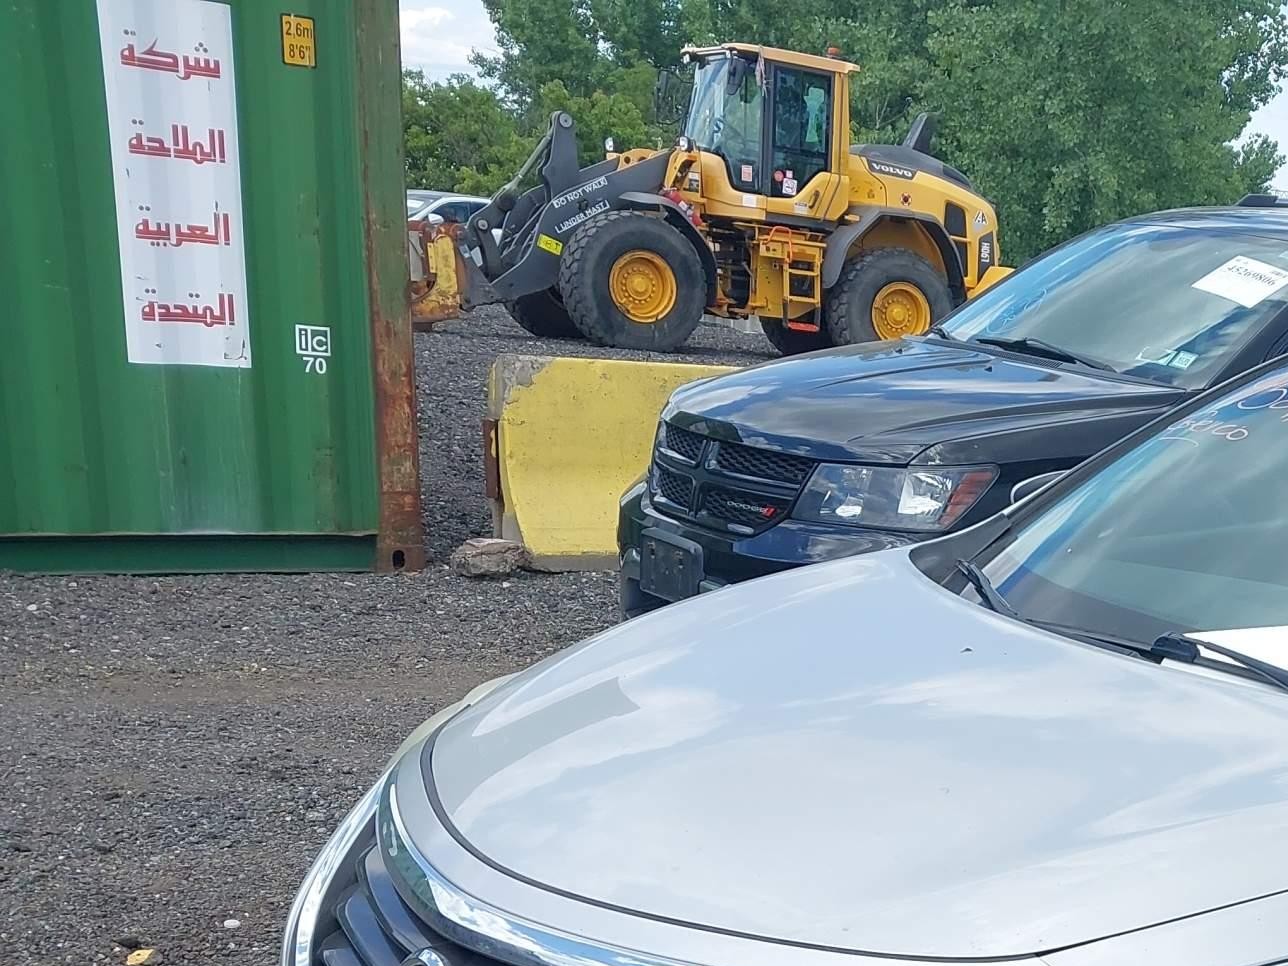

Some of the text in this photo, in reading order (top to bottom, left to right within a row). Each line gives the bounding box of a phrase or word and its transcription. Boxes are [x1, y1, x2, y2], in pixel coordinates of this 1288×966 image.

[120, 29, 221, 81] شركة
[128, 118, 226, 165] الملاحة
[871, 162, 913, 178] VOLVO
[553, 176, 606, 209] DO NOT WALK
[135, 204, 231, 247] العربية
[560, 201, 605, 229] UNDER MAST
[141, 288, 235, 327] المتحدة
[302, 357, 327, 374] 70
